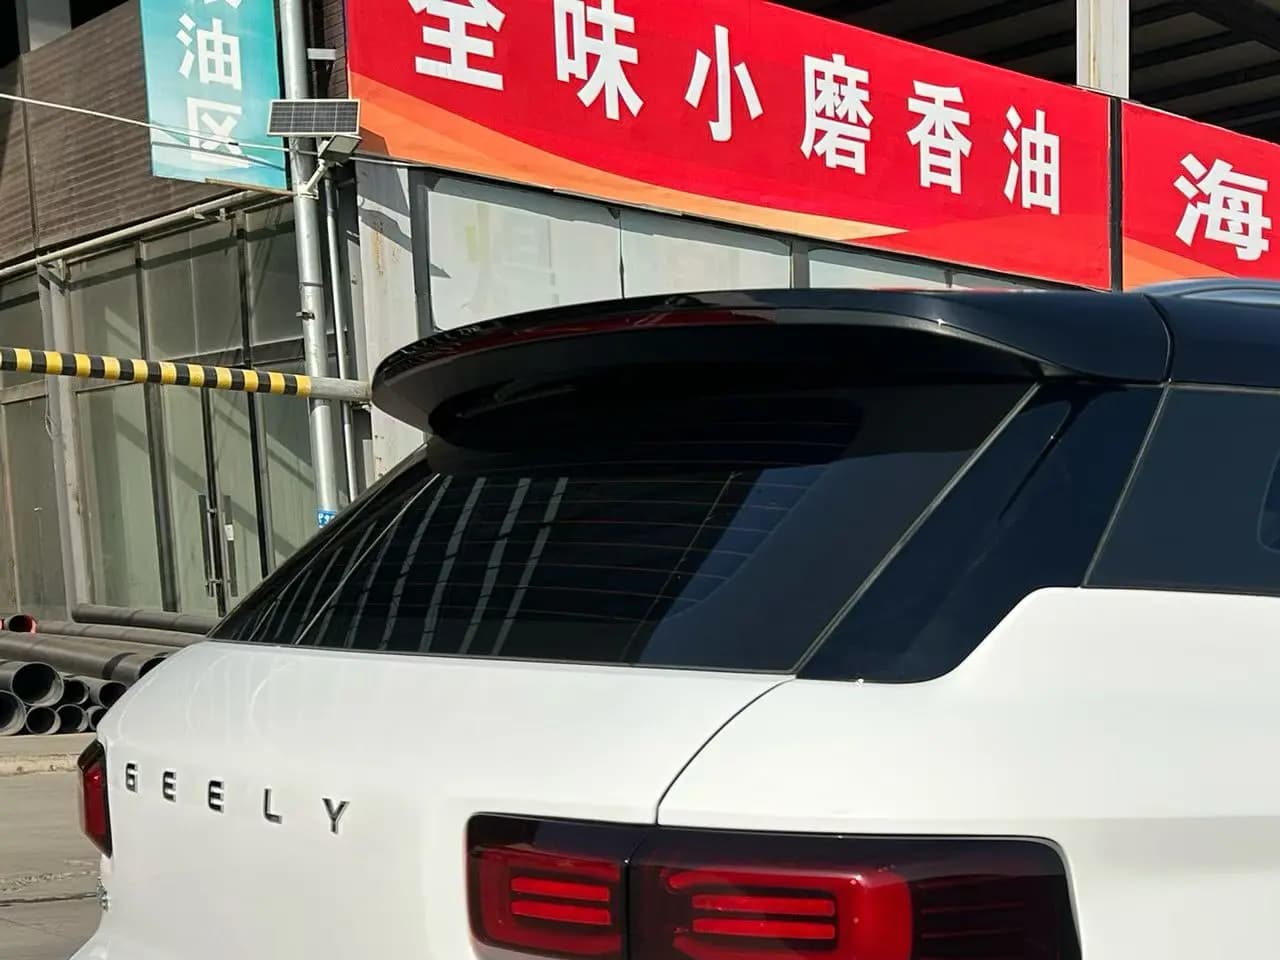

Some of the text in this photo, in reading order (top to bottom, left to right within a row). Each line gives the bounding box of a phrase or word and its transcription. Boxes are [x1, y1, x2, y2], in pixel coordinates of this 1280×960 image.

[176, 0, 250, 168] 油区
[408, 0, 1061, 215] 全味小磨香油
[125, 762, 349, 834] GEELY
